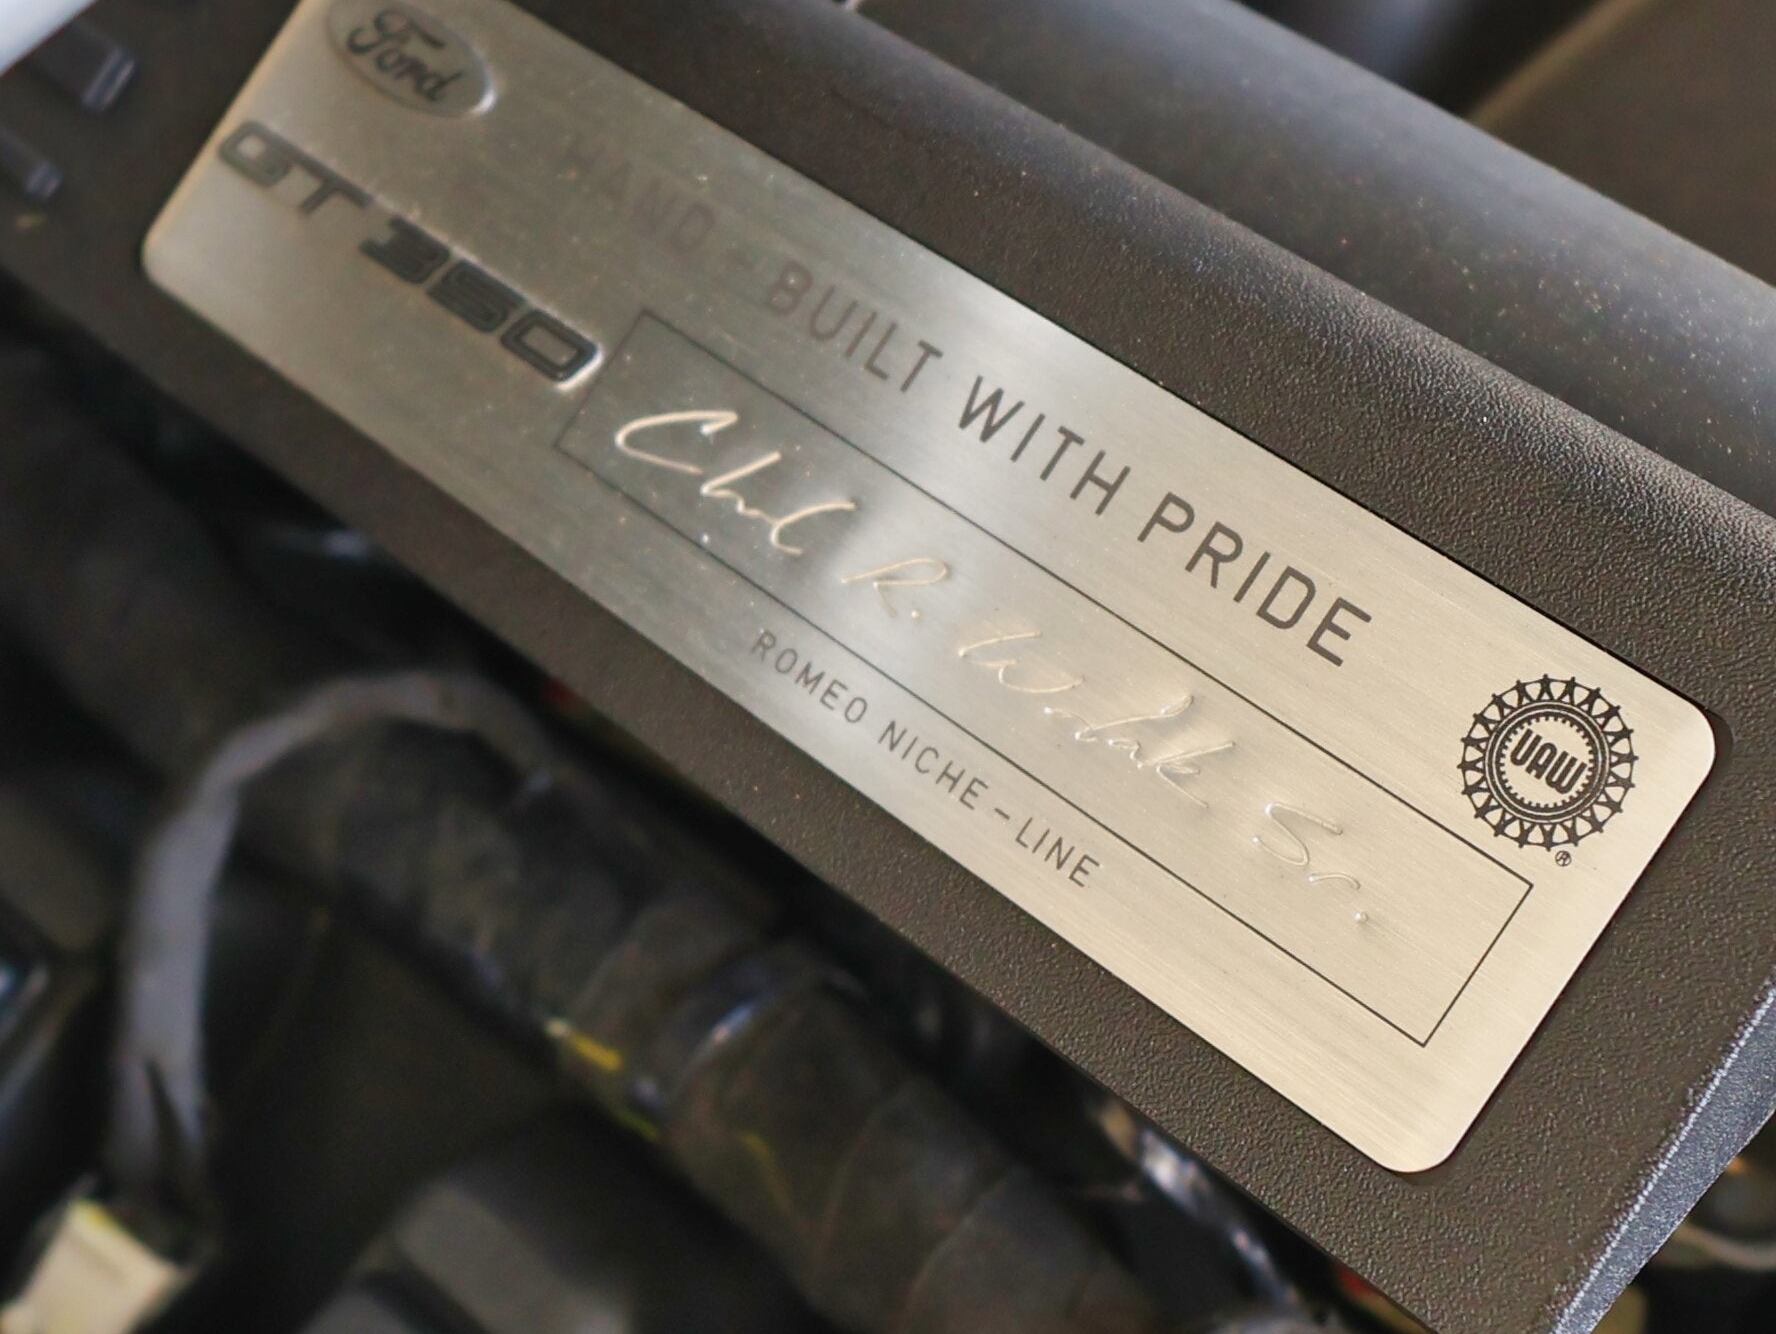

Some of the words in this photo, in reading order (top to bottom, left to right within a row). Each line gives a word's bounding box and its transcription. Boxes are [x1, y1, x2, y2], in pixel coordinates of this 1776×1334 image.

[346, 5, 463, 105] Ford
[958, 375, 1130, 517] WITH
[1138, 492, 1373, 668] PRIDE
[754, 628, 868, 726] ROMEO
[1509, 728, 1588, 795] UAW
